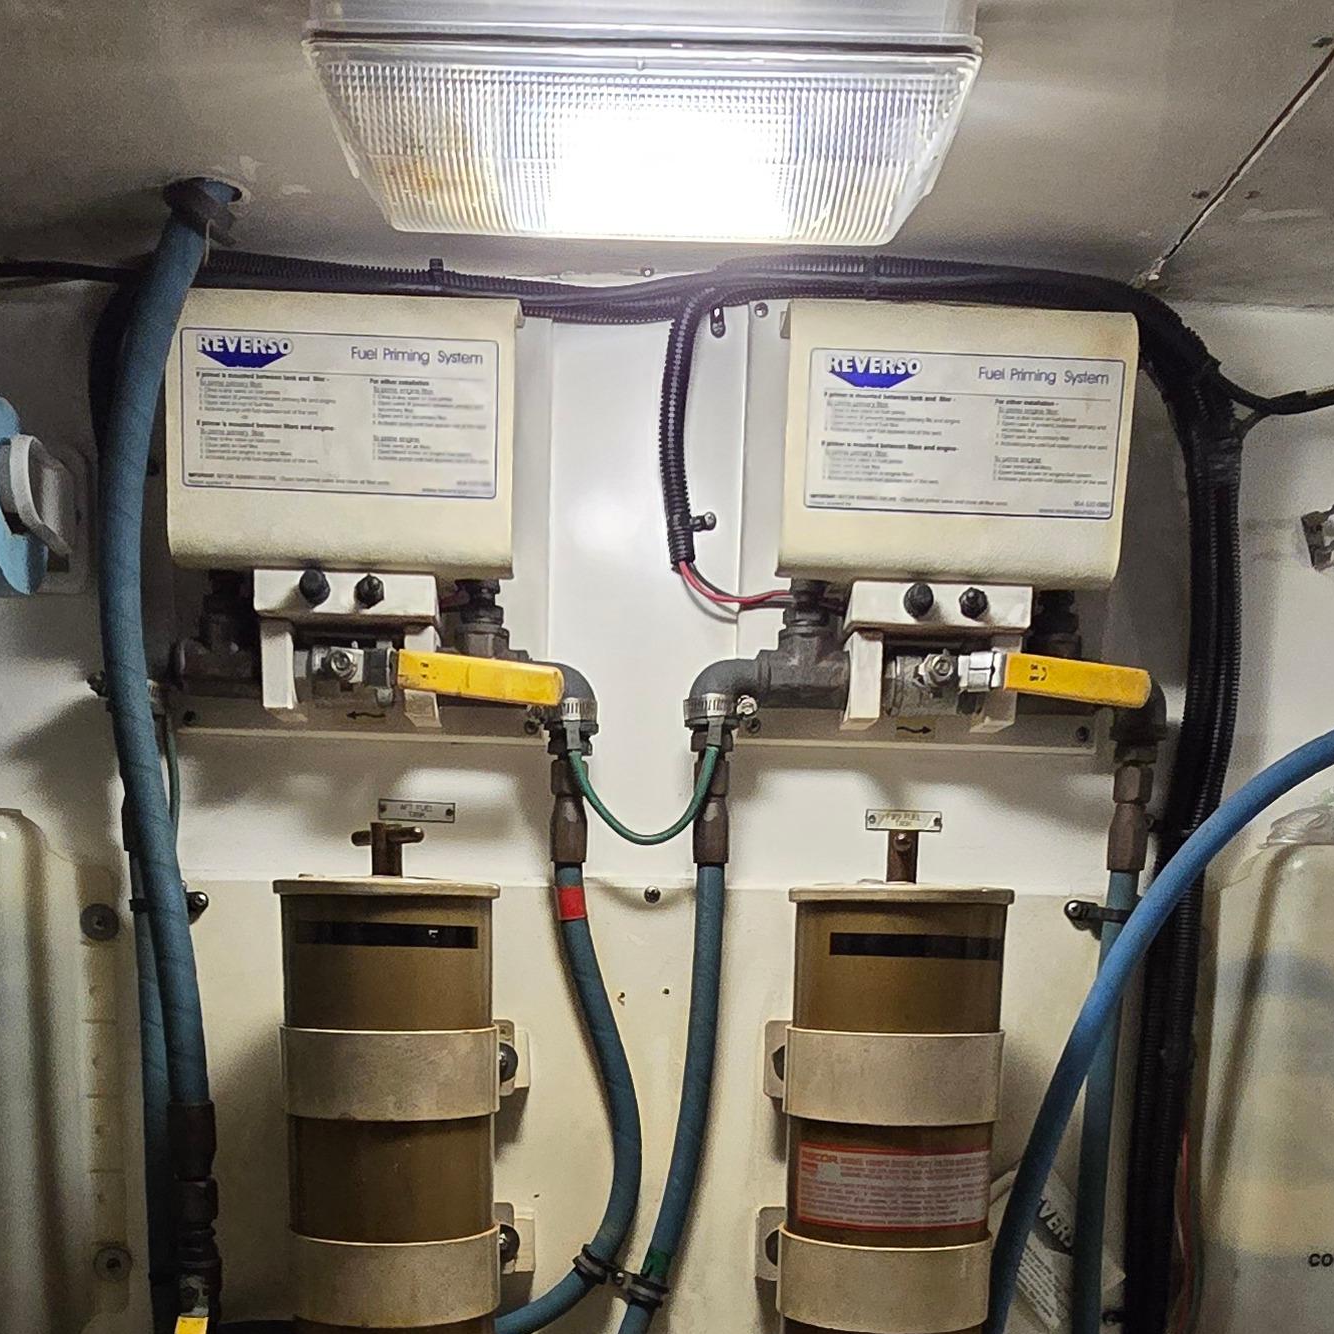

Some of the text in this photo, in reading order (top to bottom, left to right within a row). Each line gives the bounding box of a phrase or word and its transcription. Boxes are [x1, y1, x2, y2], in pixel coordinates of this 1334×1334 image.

[197, 334, 294, 355] REVERSO
[351, 346, 483, 365] Fuel Priming System
[828, 355, 922, 375] REVERSO
[978, 366, 1109, 386] Fuel Priming System
